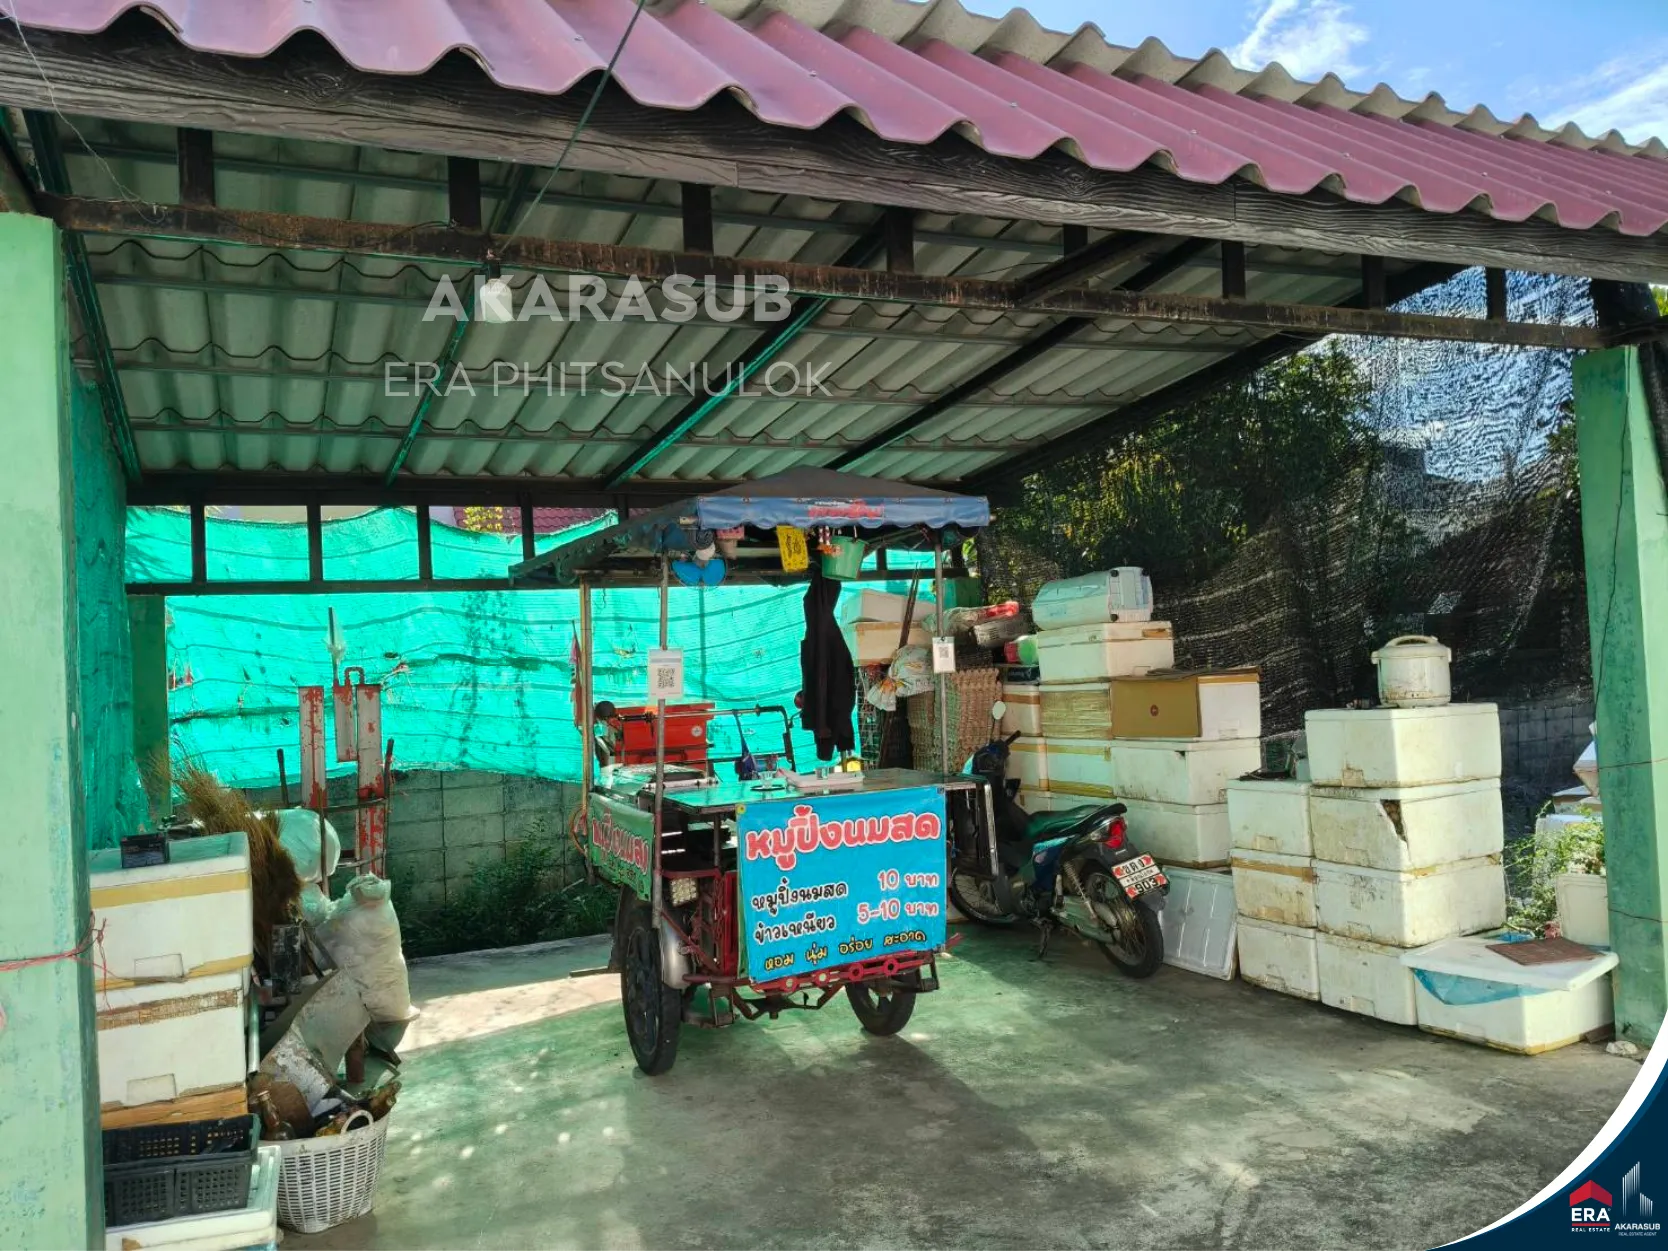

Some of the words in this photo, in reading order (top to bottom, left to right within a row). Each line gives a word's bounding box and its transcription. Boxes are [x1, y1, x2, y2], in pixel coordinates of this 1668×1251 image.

[745, 805, 940, 870] หมูปิ้งนมสด
[878, 869, 899, 889] 10
[904, 872, 939, 888] บาท
[1135, 878, 1158, 893] 903
[857, 899, 900, 924] 5-10
[904, 901, 939, 916] บาท
[765, 953, 795, 971] หอม
[805, 943, 828, 965] นุ่ม
[839, 935, 873, 955] อร่อย
[883, 929, 926, 947] สะอาด
